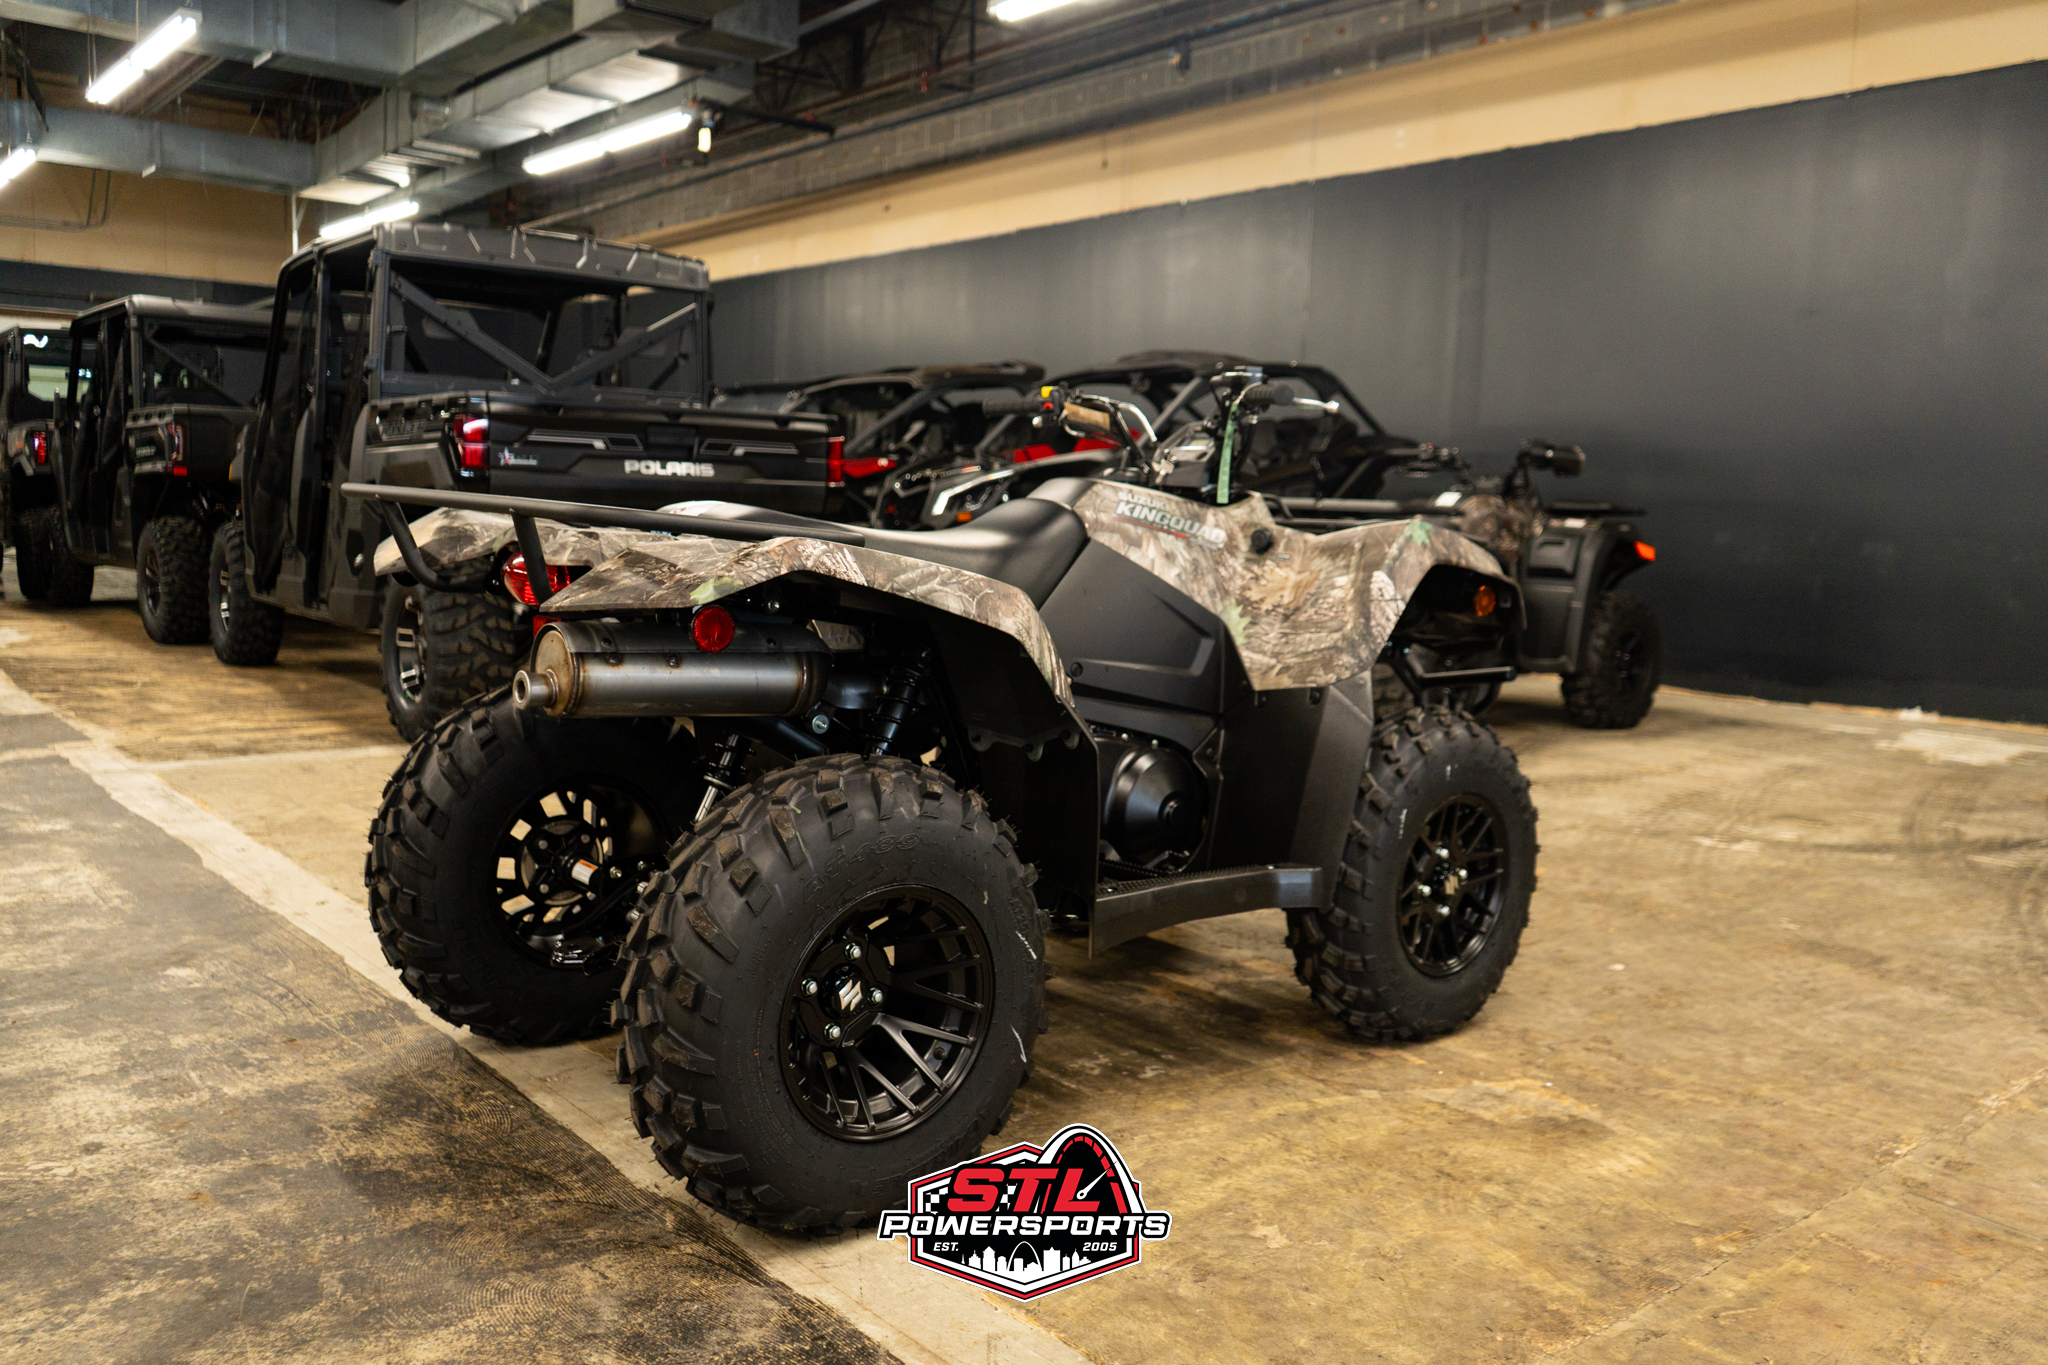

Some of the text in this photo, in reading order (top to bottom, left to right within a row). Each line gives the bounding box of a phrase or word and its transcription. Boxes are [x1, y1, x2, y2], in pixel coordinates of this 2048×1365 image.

[624, 459, 715, 477] POLARIS
[1118, 490, 1170, 509] SUZUKI
[1115, 502, 1228, 544] KINGQUAD
